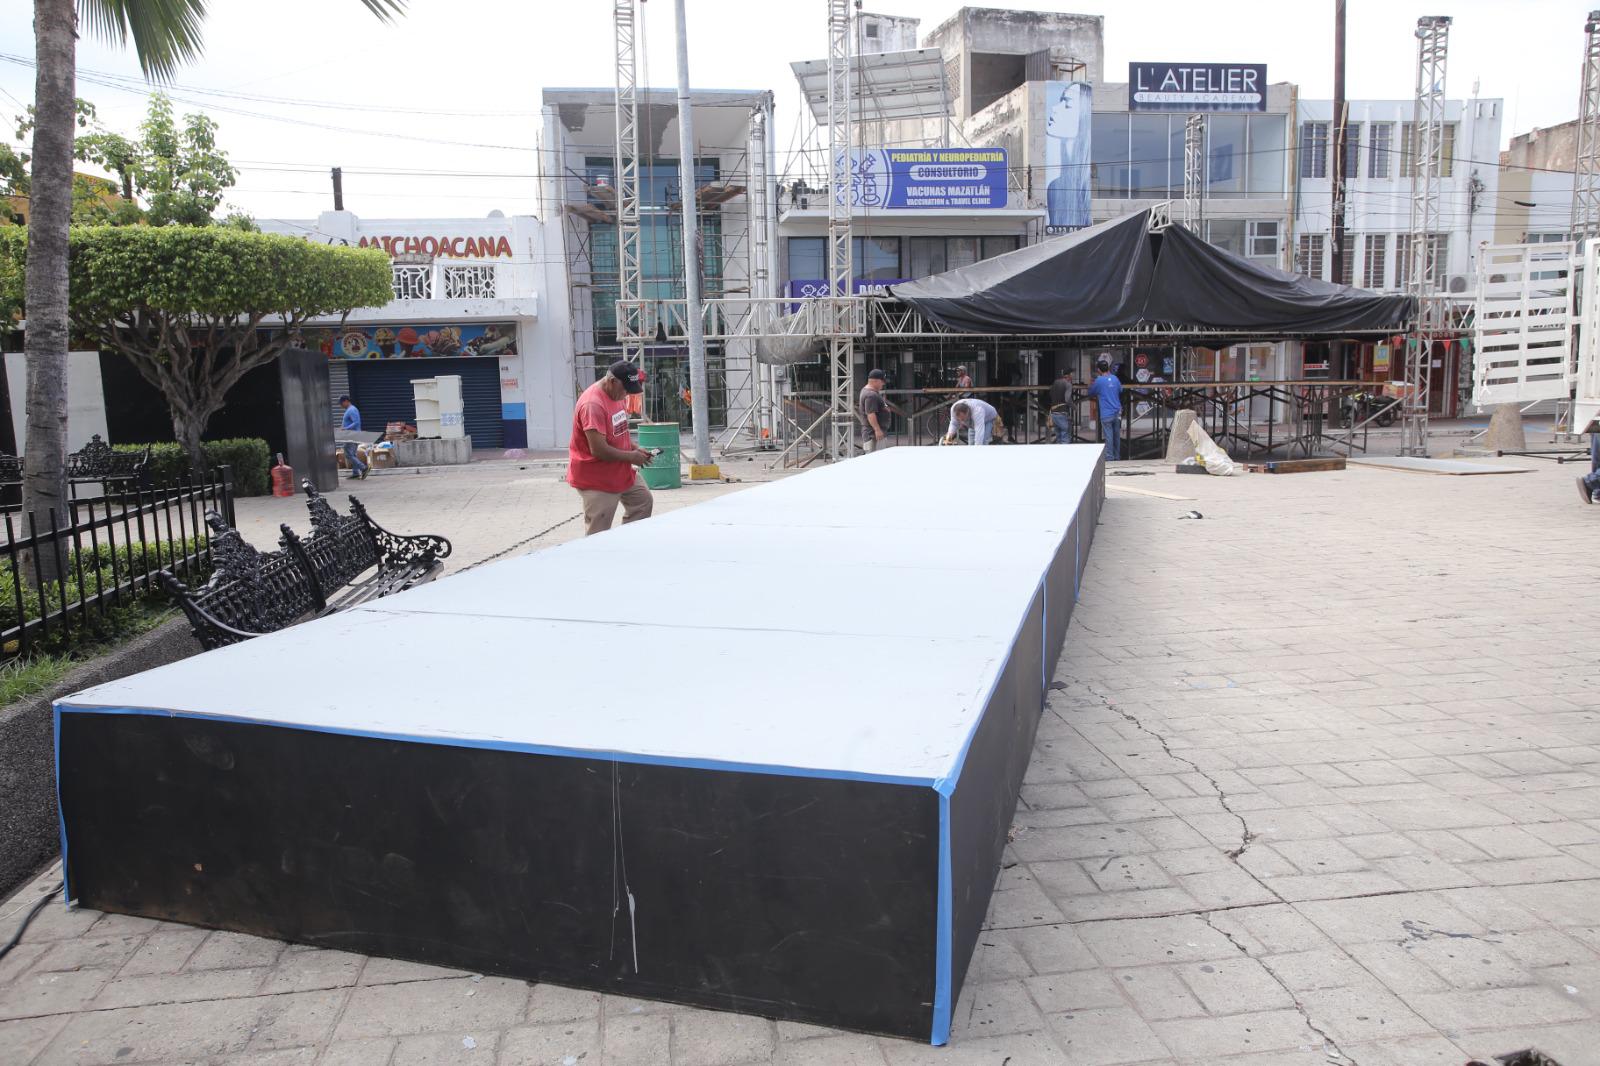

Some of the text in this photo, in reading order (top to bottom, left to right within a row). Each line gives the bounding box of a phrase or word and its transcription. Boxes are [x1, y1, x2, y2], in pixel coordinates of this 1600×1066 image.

[1139, 94, 1254, 103] BEAUTY ACADEMY
[891, 152, 1004, 162] PEDIATRÍA Y NEUROPEDIATRÍA
[918, 167, 979, 178] CONSULTORIO
[906, 184, 990, 197] VACUNAS MAZATLÁN
[906, 198, 945, 206] VACCINATION
[971, 197, 991, 205] CLINIC
